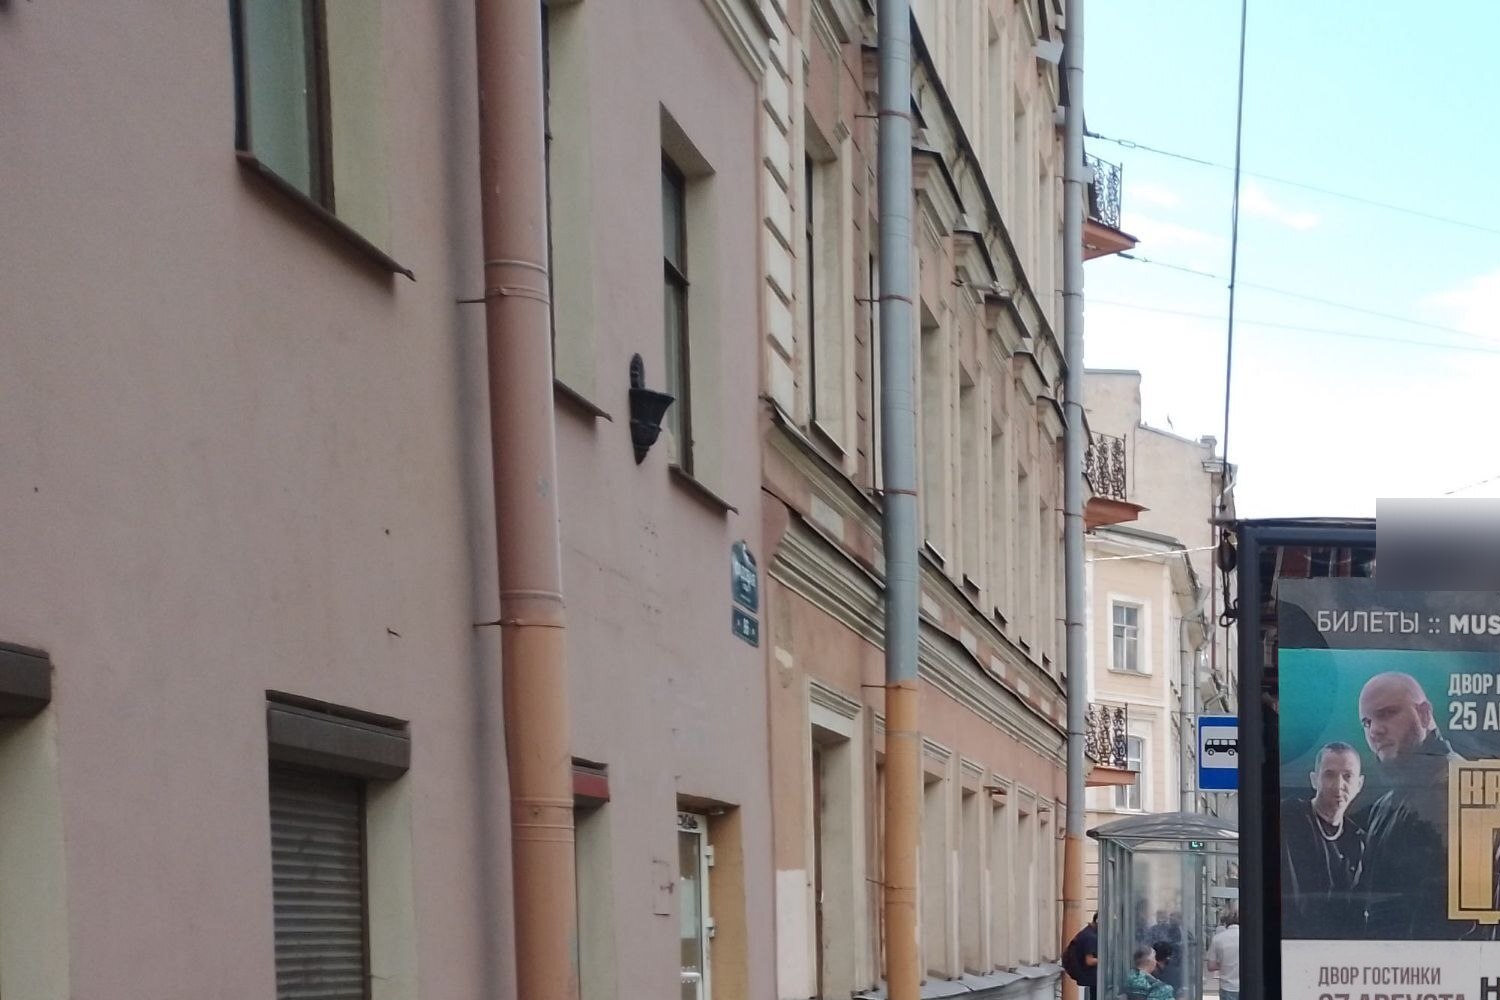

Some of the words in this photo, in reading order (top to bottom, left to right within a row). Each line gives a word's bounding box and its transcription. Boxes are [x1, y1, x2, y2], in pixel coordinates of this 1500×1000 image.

[1317, 610, 1420, 634] БИЛЕТЫ
[1448, 673, 1493, 696] ДВОР
[1449, 701, 1478, 731] 25
[1318, 966, 1360, 986] ДВОР
[1363, 967, 1441, 985] ГОСТИНКИ
